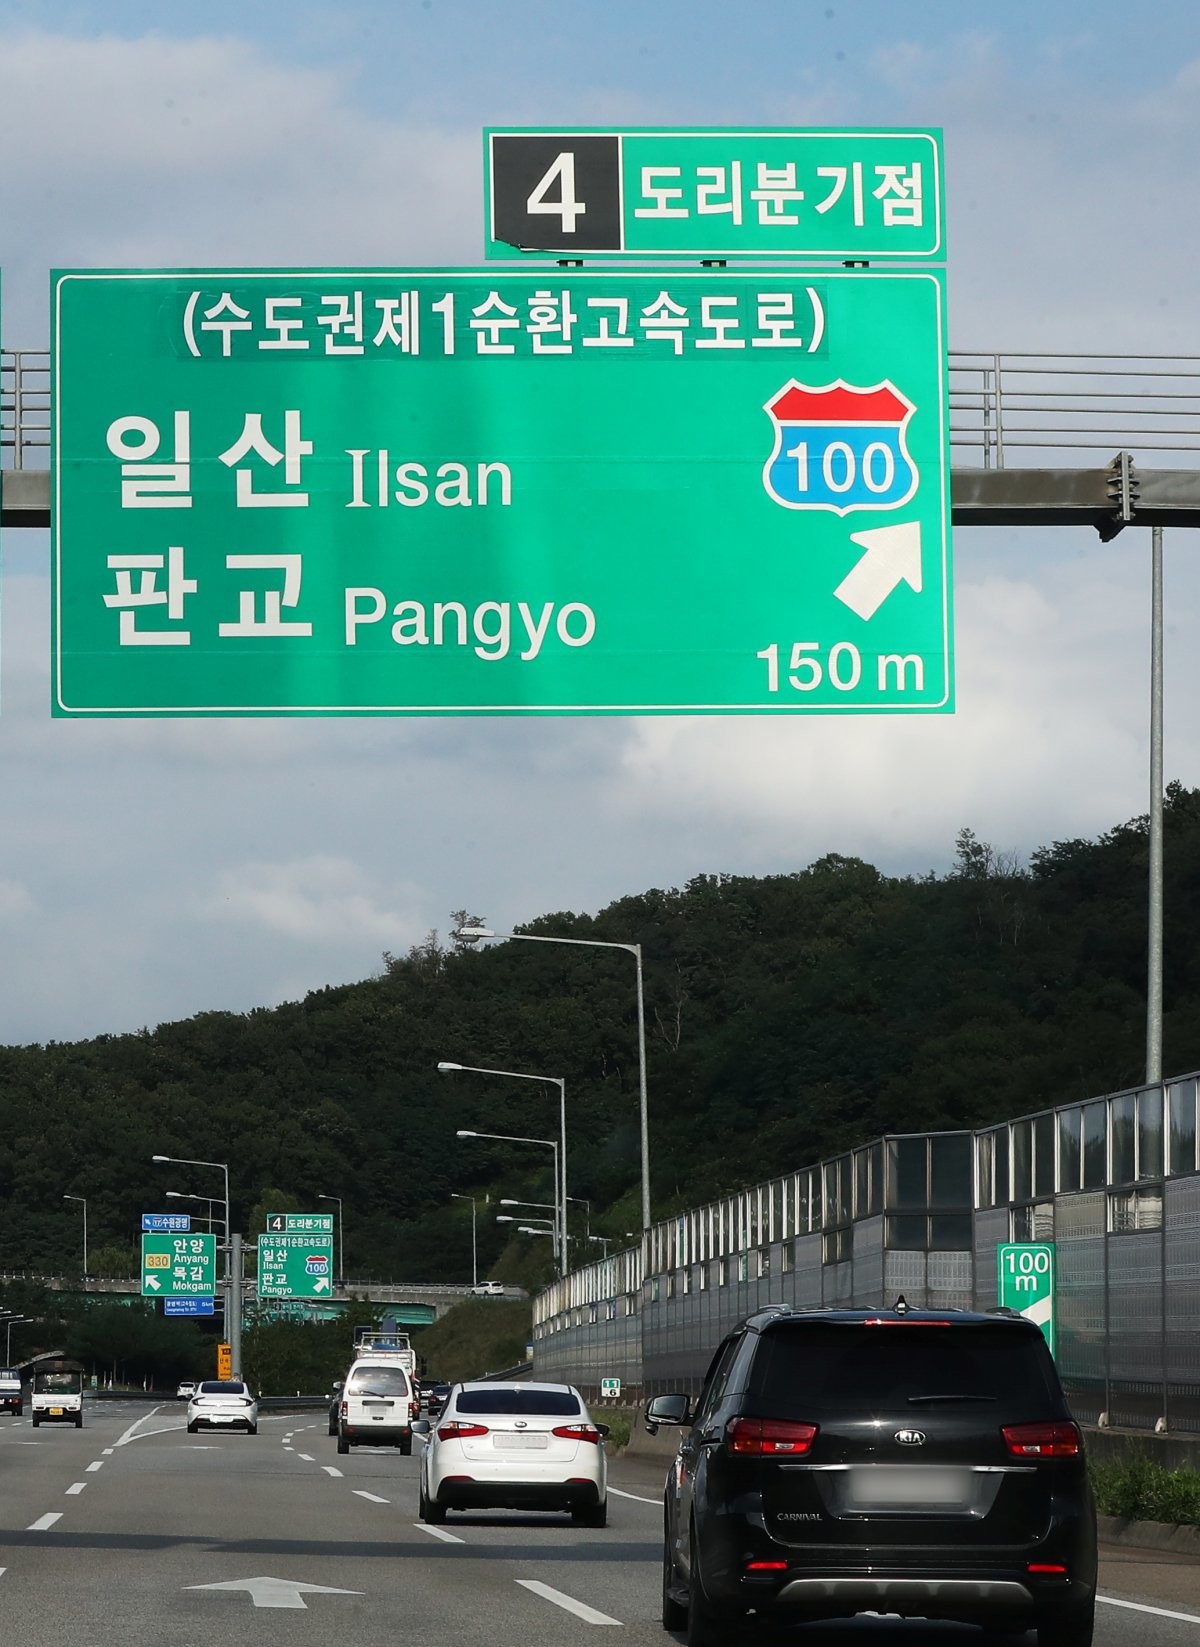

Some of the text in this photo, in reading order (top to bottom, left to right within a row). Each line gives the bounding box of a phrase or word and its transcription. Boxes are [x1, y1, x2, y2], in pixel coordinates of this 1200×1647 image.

[526, 152, 587, 233] 4
[634, 160, 924, 227] 도리분기점
[182, 287, 825, 357] (수도권제1순환고속도로)
[105, 410, 512, 508] 일산 Ilsan
[786, 441, 895, 493] 100
[102, 546, 597, 661] 판교 Pangyo
[756, 641, 925, 692] 150 m
[272, 1217, 282, 1230] 4
[287, 1218, 331, 1229] 도리분기점
[173, 1238, 204, 1253] 안양
[260, 1237, 331, 1247] (수도권제1순환고속도로)
[148, 1256, 169, 1267] 330
[173, 1254, 209, 1265] Anyang
[263, 1249, 288, 1262] 일산
[263, 1262, 284, 1270] Ilsan
[308, 1263, 326, 1273] 100
[1005, 1252, 1049, 1274] 100
[173, 1266, 204, 1281] 목감
[262, 1273, 288, 1286] 판교
[172, 1281, 212, 1292] Mokgam
[1015, 1275, 1038, 1292] m
[261, 1286, 293, 1295] Pangyo
[604, 1380, 618, 1388] 11
[899, 1431, 922, 1443] KIA
[776, 1512, 823, 1521] CARNIVAL
